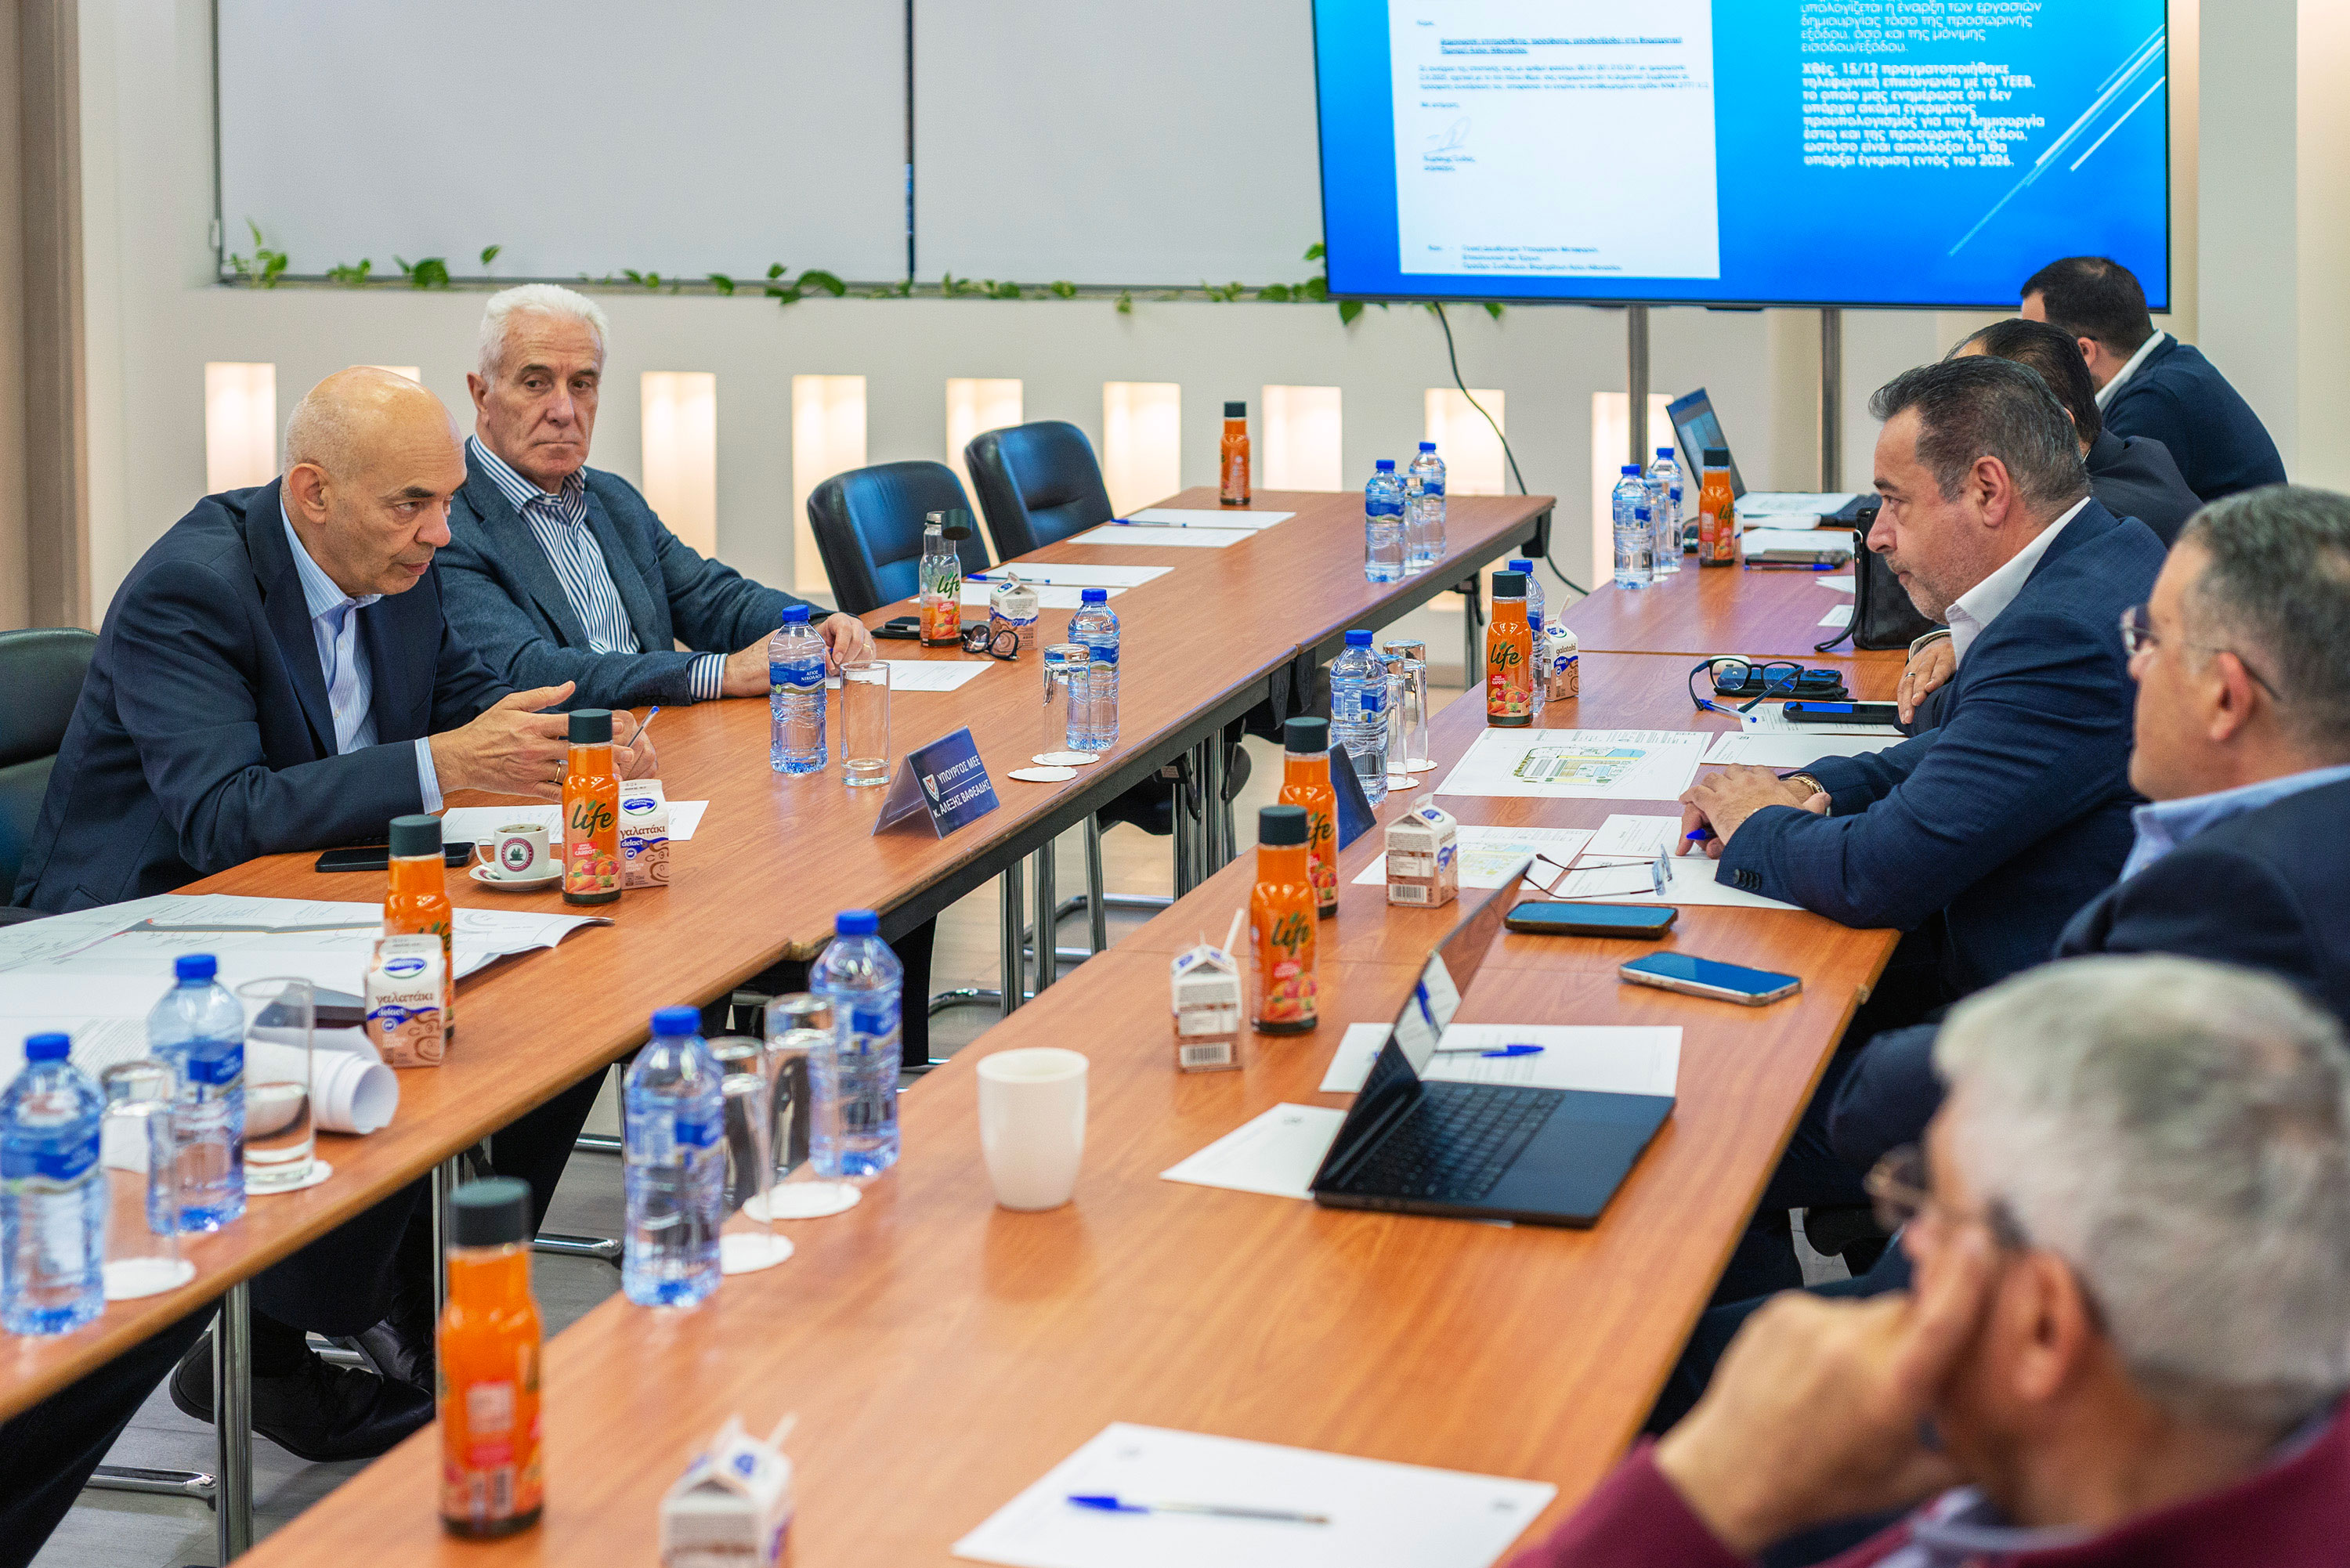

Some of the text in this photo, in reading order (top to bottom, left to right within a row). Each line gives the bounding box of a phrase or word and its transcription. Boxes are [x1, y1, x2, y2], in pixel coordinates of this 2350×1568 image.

[1799, 0, 2042, 15] υπολογίζεται η έναρξη των εργασιών
[1801, 13, 2033, 28] δημιουργίας τόσο της προσωρινής
[1884, 30, 1905, 38] και
[1907, 30, 1930, 41] της
[1932, 27, 1986, 41] μόνιμης
[1842, 62, 1878, 75] 15/12
[1881, 61, 2010, 76] πραγματοποιήθηκε
[1802, 75, 1880, 89] τηλεφωνική
[1882, 74, 1961, 87] επικοινωνία
[1963, 77, 1979, 89] με
[1981, 77, 1998, 86] το
[1802, 87, 2012, 103] το οποίο μας ενημέρωσε ότι δεν
[1802, 101, 1856, 116] υπάρχει
[1857, 101, 1901, 116] ακόμη
[1919, 116, 1942, 128] για
[1943, 116, 1967, 128] την
[1969, 113, 2045, 128] δημιουργία
[1803, 127, 1838, 139] έστω
[1839, 129, 1861, 139] και
[1863, 129, 1886, 142] της
[1889, 126, 1974, 141] προσωρινής
[1803, 139, 1859, 152] ωστόσο
[1860, 139, 1891, 152] είναι
[1966, 139, 1986, 151] ότι
[1987, 139, 2008, 151] θα
[1803, 153, 1856, 168] υπάρξει
[1857, 152, 1911, 167] έγκριση
[1912, 152, 1950, 167] εντός
[1952, 154, 1976, 164] του
[937, 571, 960, 599] life
[1490, 641, 1523, 672] life
[937, 755, 981, 784] ΥΠΟΥΡΓΟΣ ΜΕΕ
[939, 794, 963, 815] ΑΛΕΞΗΣ
[960, 779, 992, 803] ΒΑΦΕΑΔΗΣ
[572, 800, 615, 838] life
[620, 824, 666, 839] γαλατάκι
[621, 839, 643, 847] delact
[375, 990, 434, 1006] γαλατάκι
